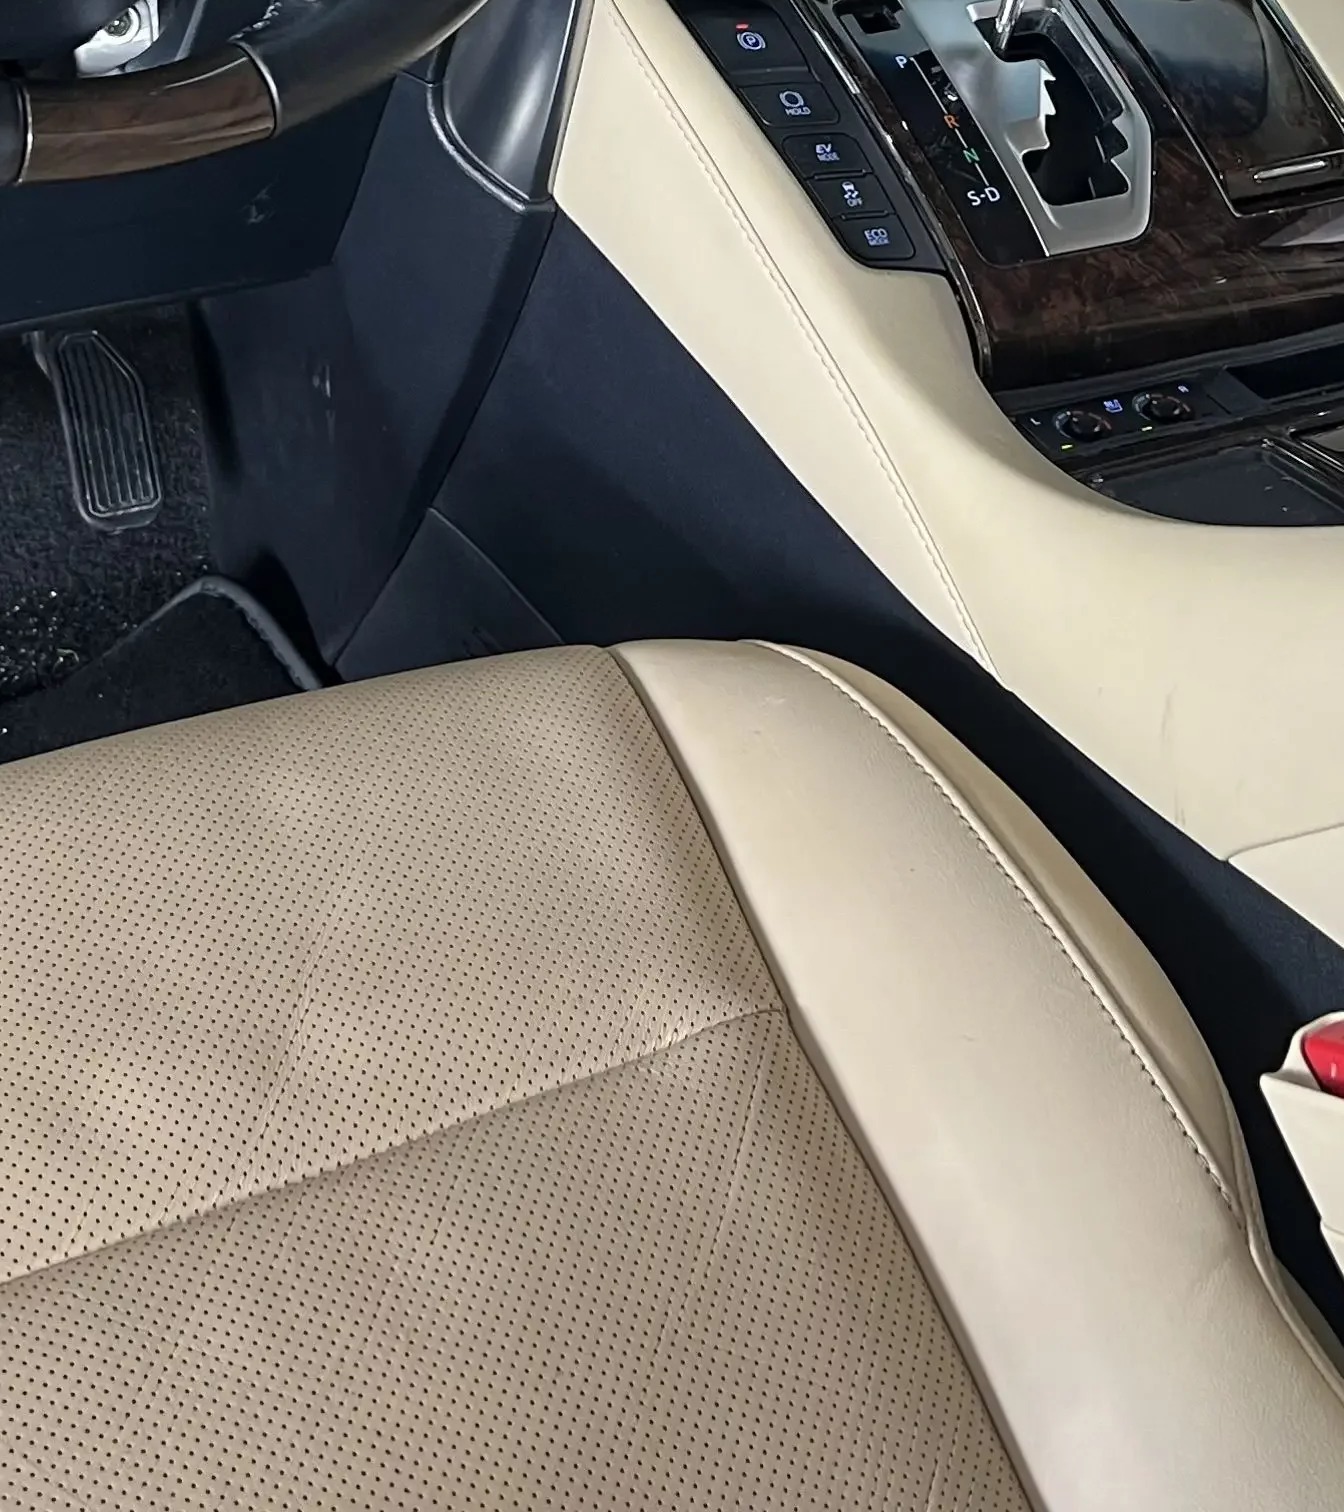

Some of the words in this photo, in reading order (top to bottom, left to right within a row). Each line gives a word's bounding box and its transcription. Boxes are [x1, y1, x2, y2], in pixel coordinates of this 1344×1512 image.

[895, 55, 908, 69] P
[785, 107, 811, 116] HOLD
[944, 114, 959, 128] R
[816, 143, 832, 153] EV
[963, 148, 979, 163] N
[864, 228, 887, 240] ECO
